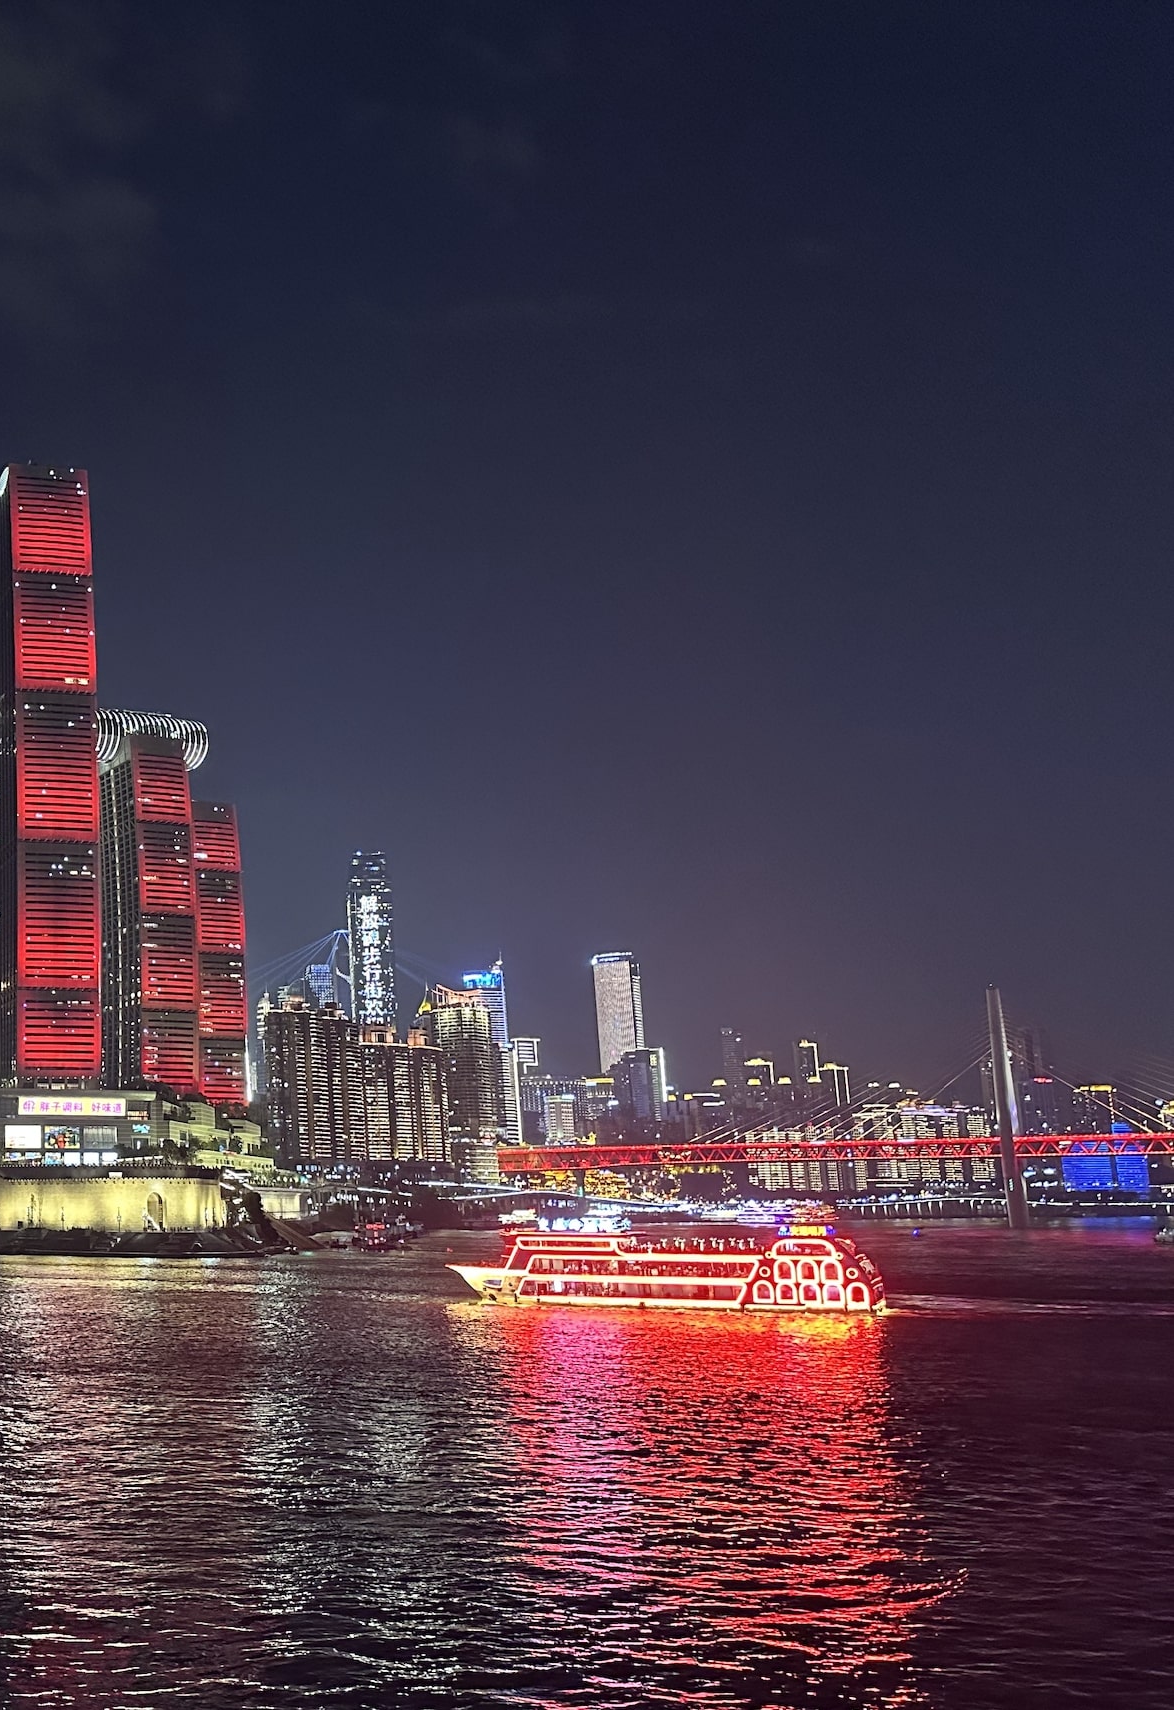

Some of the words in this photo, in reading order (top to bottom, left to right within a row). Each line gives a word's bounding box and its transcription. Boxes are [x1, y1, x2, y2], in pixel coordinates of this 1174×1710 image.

[39, 1102, 82, 1112] 胖子调料
[92, 1103, 122, 1113] 好味道
